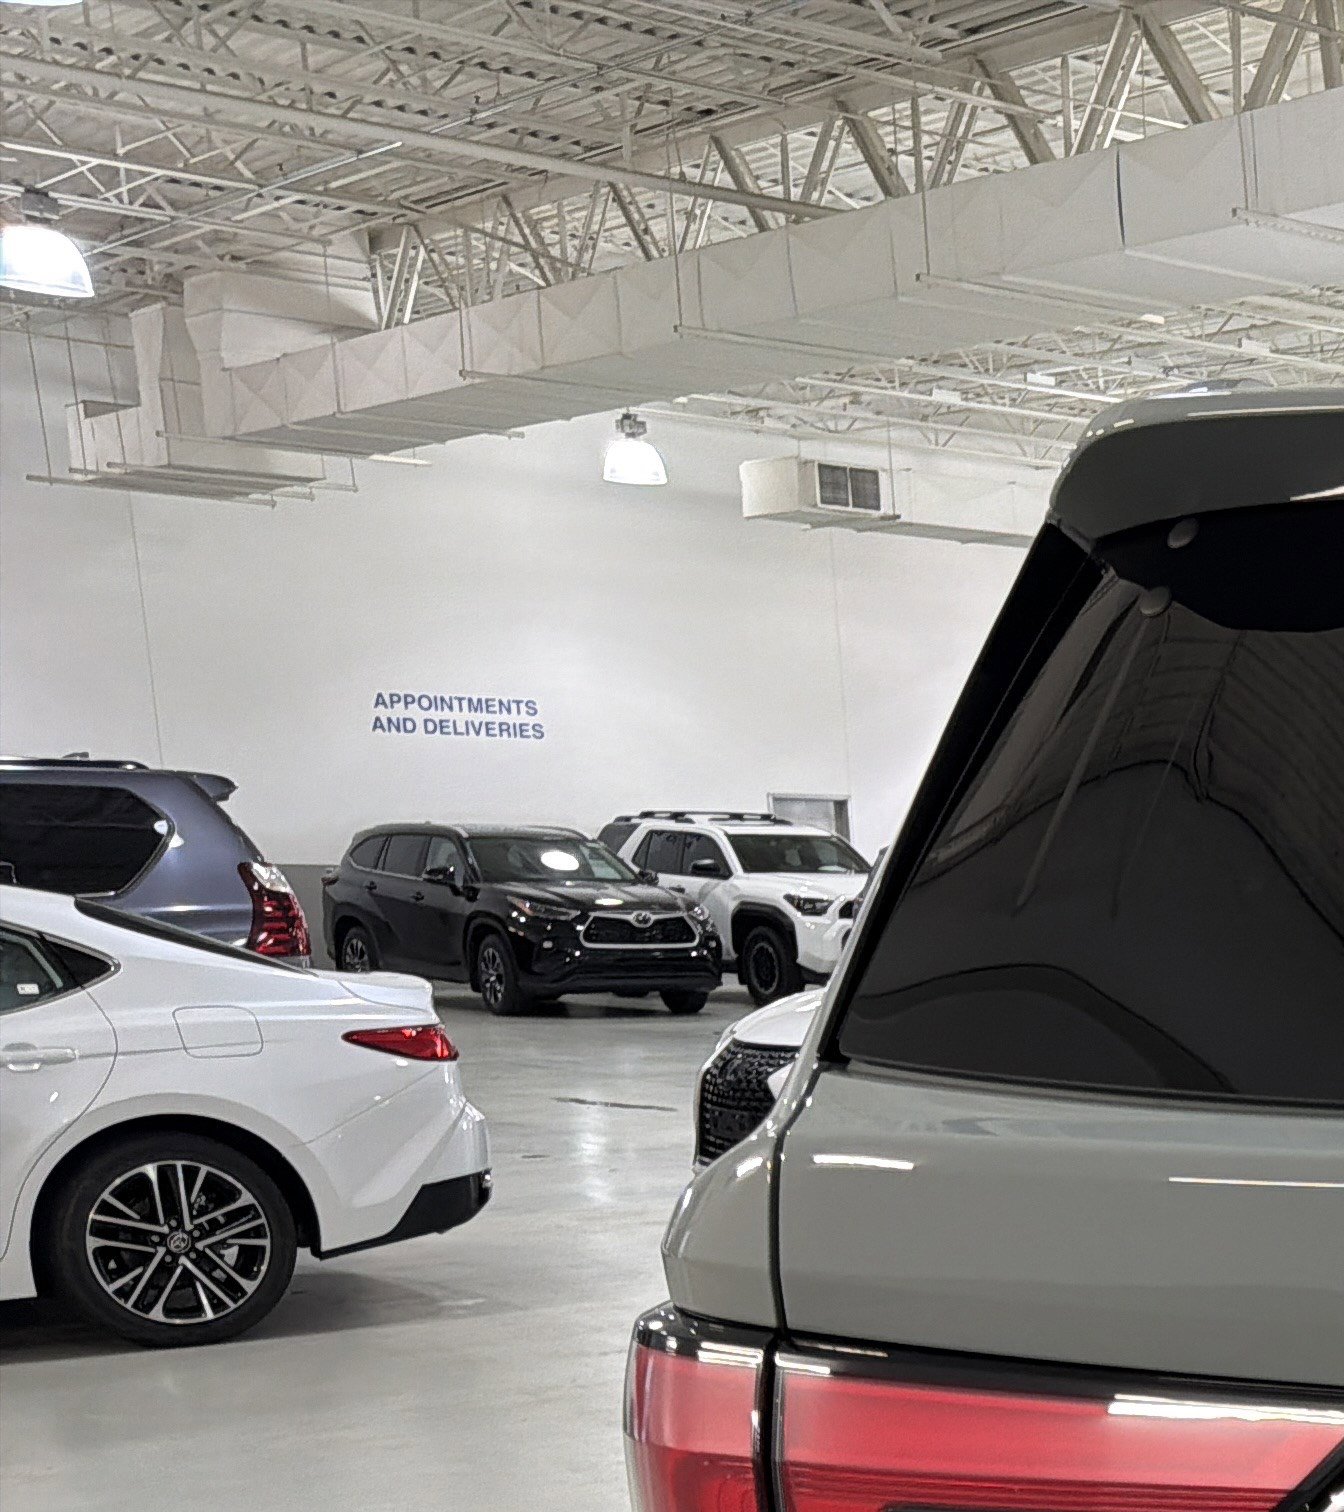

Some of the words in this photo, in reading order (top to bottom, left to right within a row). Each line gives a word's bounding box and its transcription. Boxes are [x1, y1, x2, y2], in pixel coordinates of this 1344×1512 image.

[373, 691, 539, 717] APPOINTMENTS
[371, 716, 417, 734] AND
[423, 718, 545, 740] DELIVERIES
